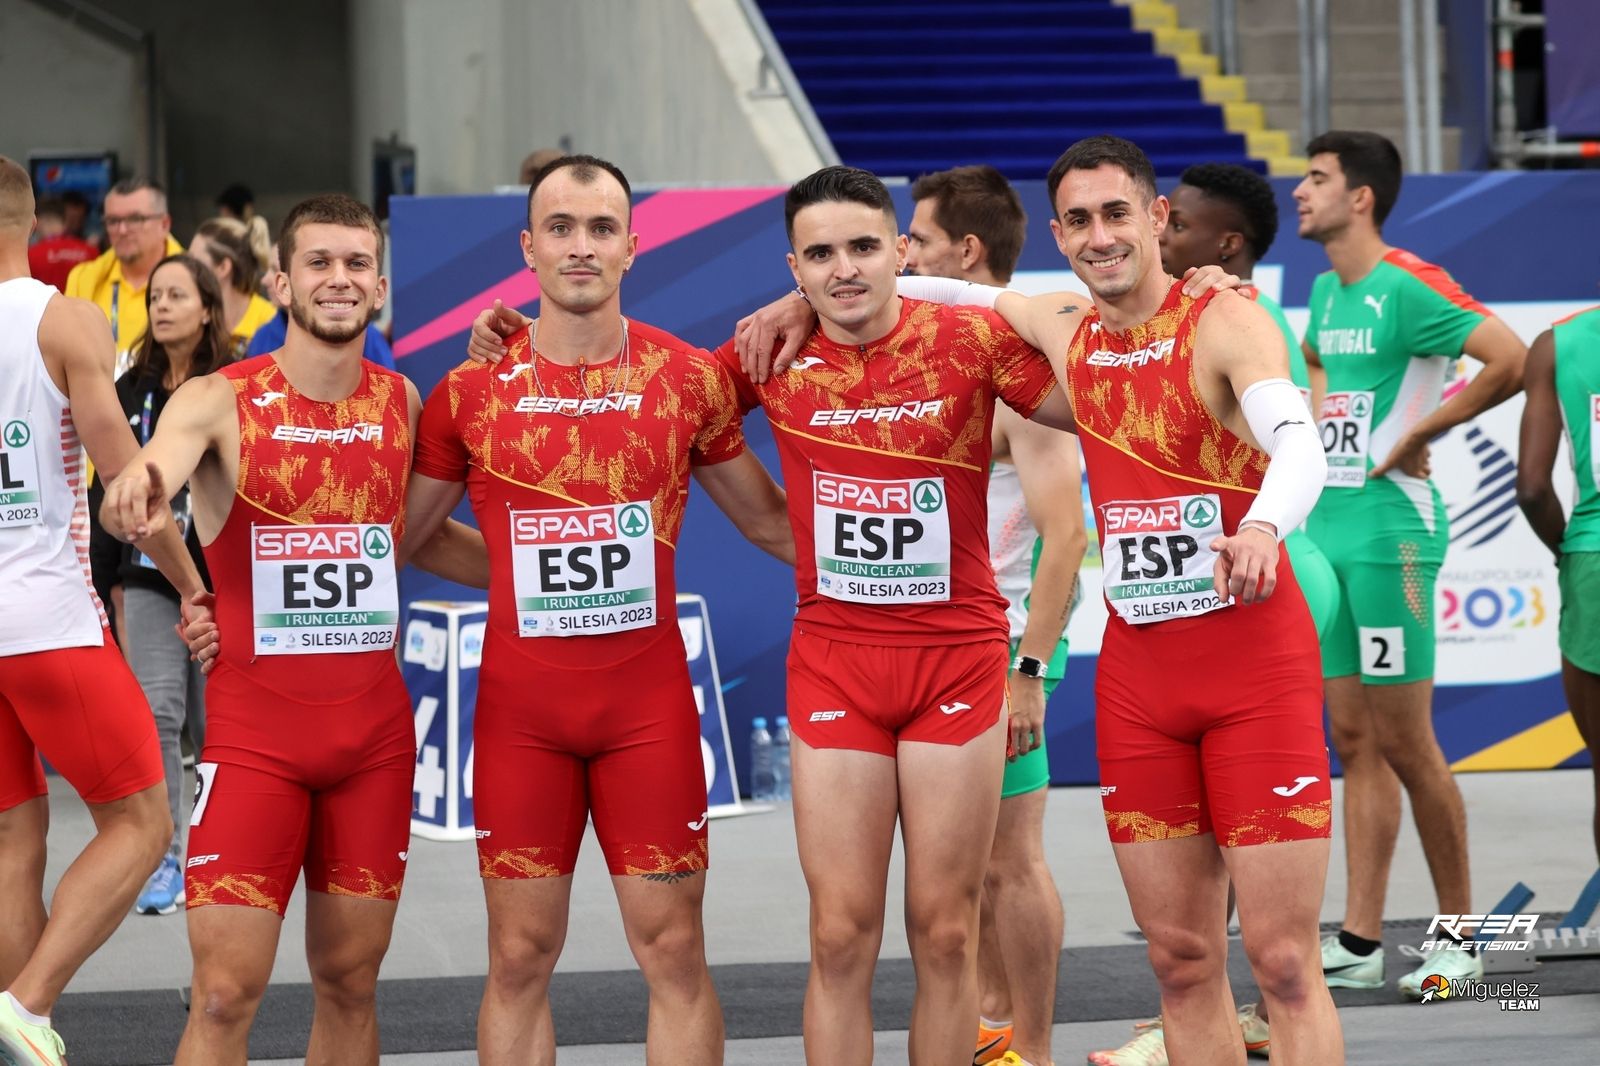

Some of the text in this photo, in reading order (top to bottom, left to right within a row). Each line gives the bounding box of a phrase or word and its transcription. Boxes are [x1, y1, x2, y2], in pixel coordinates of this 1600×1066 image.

[1086, 337, 1176, 368] ESPAÑA
[1318, 328, 1376, 354] PORTUGAL
[514, 391, 644, 415] ESPAÑA
[809, 400, 943, 426] ESPAÑA
[271, 422, 384, 444] ESPAÑA
[818, 479, 908, 509] SPAR
[7, 508, 39, 521] 2023
[1106, 505, 1178, 529] SPAR
[517, 513, 614, 540] SPAR
[834, 512, 924, 561] ESP
[258, 531, 358, 556] SPAR
[538, 543, 631, 593] ESP
[835, 562, 839, 571] I
[841, 562, 868, 574] RUN
[1118, 534, 1198, 581] ESP
[283, 563, 374, 609] ESP
[848, 582, 905, 597] SILESIA
[908, 582, 946, 596] 2023
[1121, 588, 1126, 597] I
[1127, 585, 1151, 597] RUN
[543, 599, 548, 609] I
[551, 598, 579, 609] RUN
[1133, 596, 1230, 617] SILESIA 202
[286, 615, 290, 625] I
[293, 614, 322, 625] RUN
[559, 607, 653, 630] SILESIA 2023
[302, 631, 393, 647] SILESIA 2023
[1371, 637, 1392, 669] 2
[808, 710, 847, 722] ESP
[1100, 786, 1117, 796] SP
[187, 854, 220, 868] ESP
